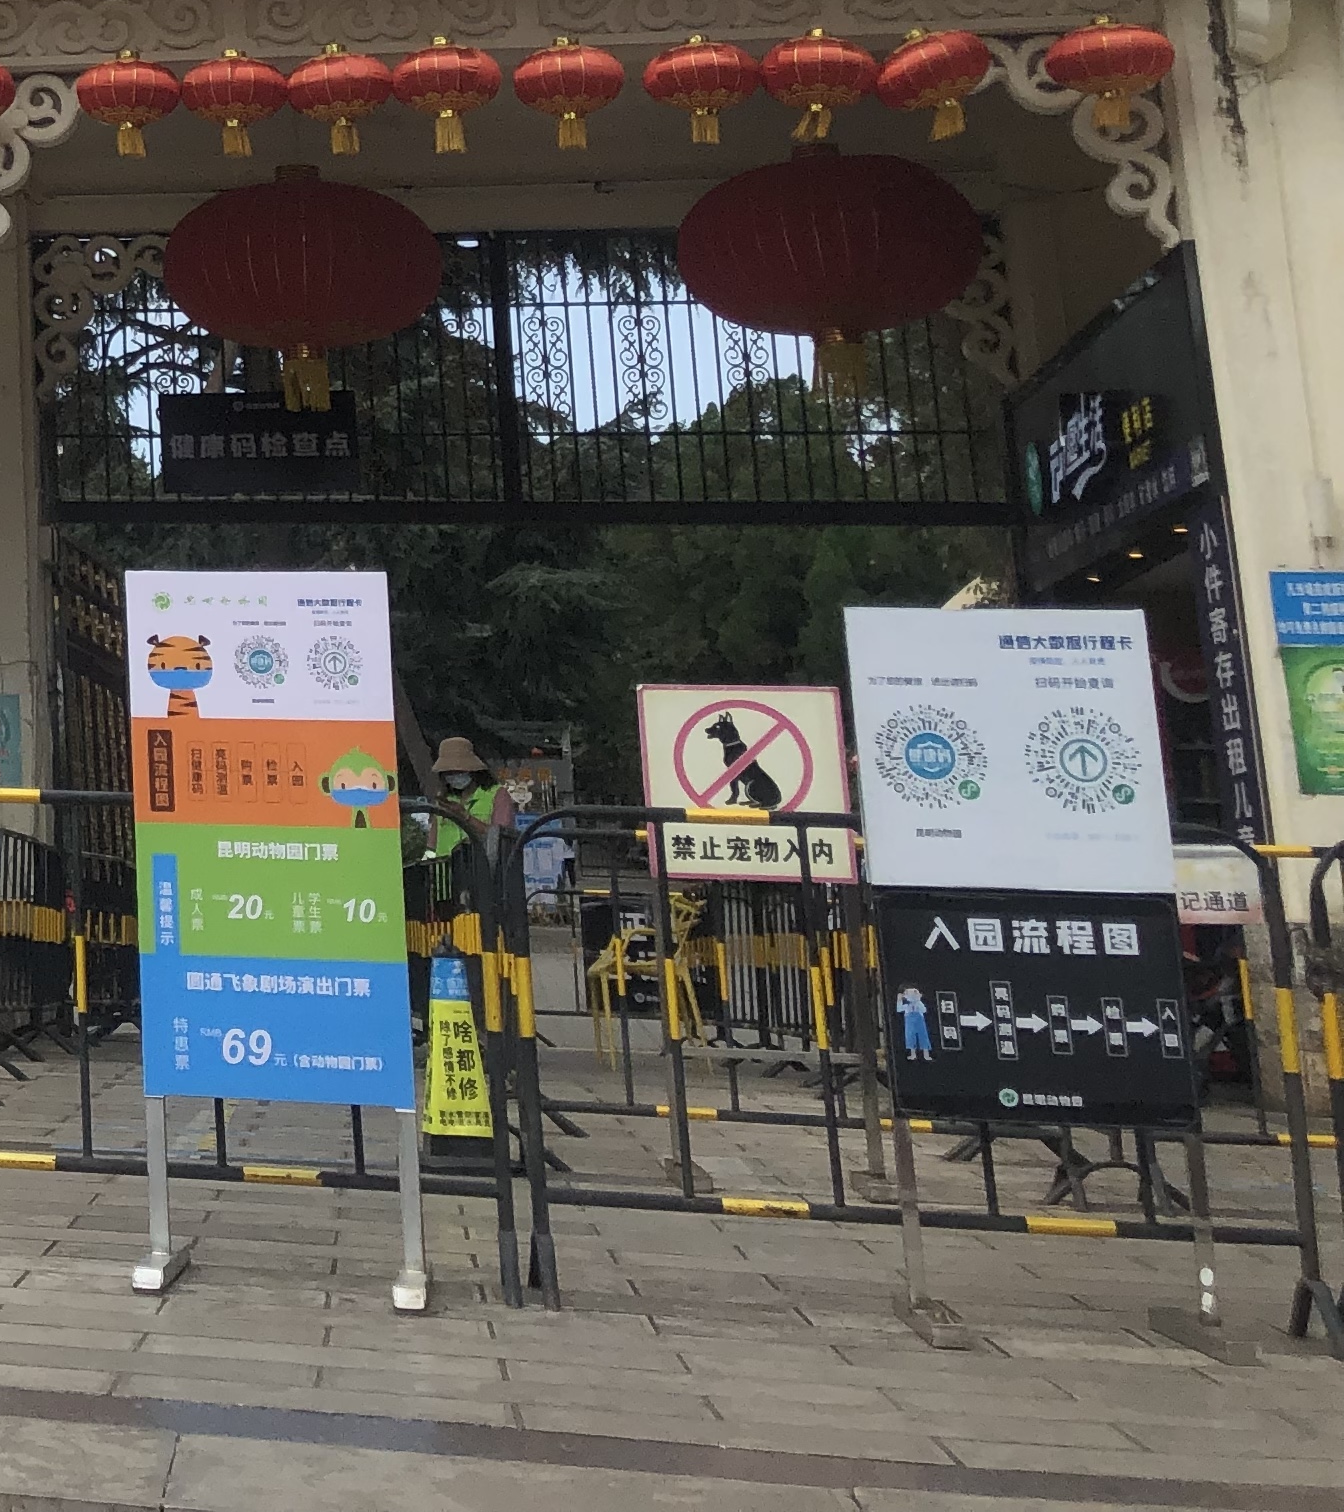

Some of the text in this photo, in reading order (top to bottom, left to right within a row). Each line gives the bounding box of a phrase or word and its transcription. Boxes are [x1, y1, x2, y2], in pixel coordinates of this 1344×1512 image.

[169, 431, 352, 459] 健康码检查点
[998, 634, 1134, 651] 通信大数据行程卡
[291, 761, 304, 787] 入园
[217, 841, 340, 862] 昆明动物园门票
[671, 834, 834, 865] 禁止宠物入内
[158, 881, 175, 947] 温馨提示
[190, 888, 204, 932] 成人票
[227, 894, 263, 920] 20
[292, 892, 306, 933] 儿童票
[308, 892, 323, 934] 学生票
[343, 898, 376, 923] 10
[924, 916, 1140, 956] 入园流程图
[173, 1016, 190, 1071] 特惠票
[222, 1028, 273, 1066] 69
[452, 1019, 479, 1102] 啥都修
